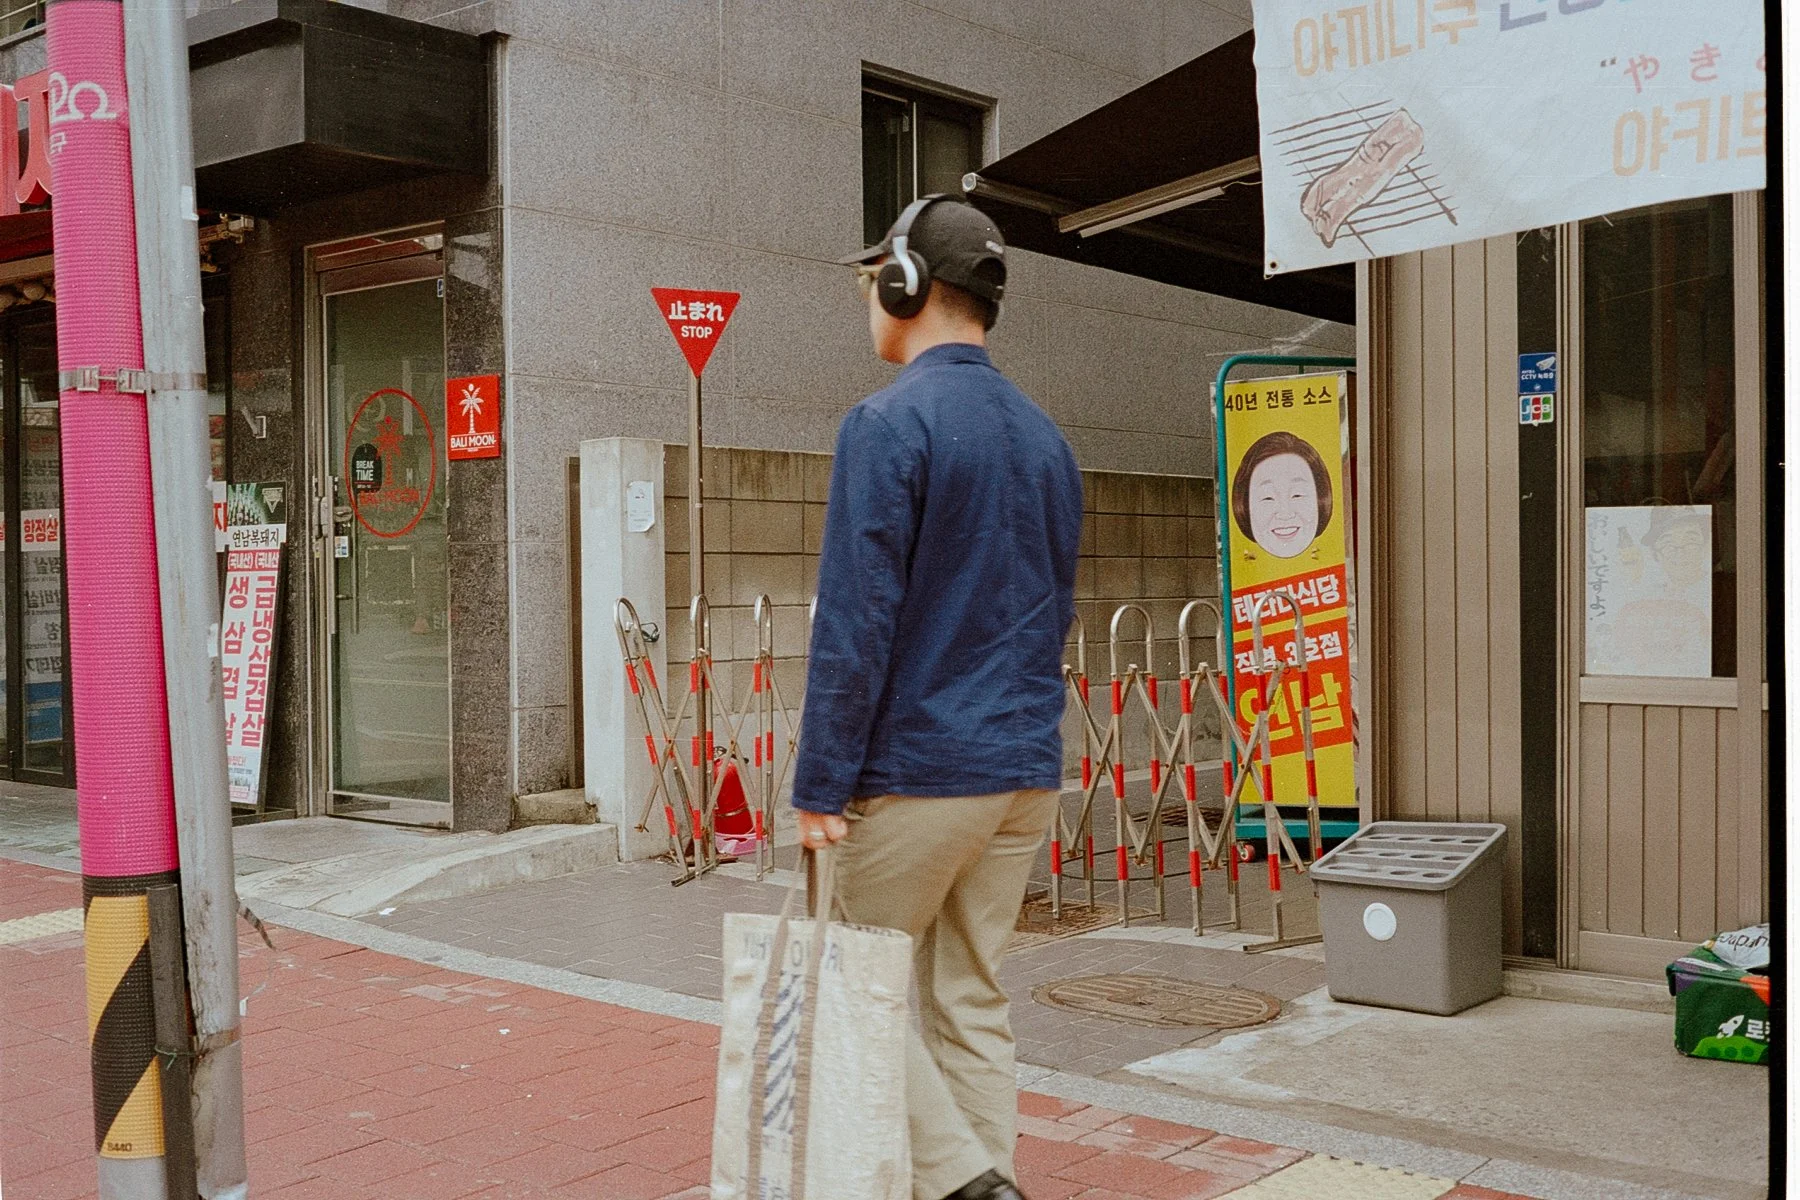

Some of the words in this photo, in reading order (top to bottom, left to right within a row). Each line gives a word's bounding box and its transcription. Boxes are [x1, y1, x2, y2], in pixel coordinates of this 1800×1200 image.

[1600, 43, 1767, 94] “やき
[668, 300, 725, 322] 止まれ
[681, 325, 713, 339] STOP
[1225, 391, 1258, 412] 40년
[1266, 388, 1294, 409] 전통
[1303, 385, 1332, 406] 소스
[450, 436, 468, 449] BALI
[468, 434, 497, 447] MOON
[355, 460, 374, 469] BREAK
[355, 469, 374, 481] TIME
[23, 518, 58, 543] 항정살
[232, 527, 280, 548] 연남복돼지
[1284, 630, 1343, 667] 3호점
[241, 574, 277, 749] 급냉삼겹살
[1239, 672, 1345, 743] 연남
